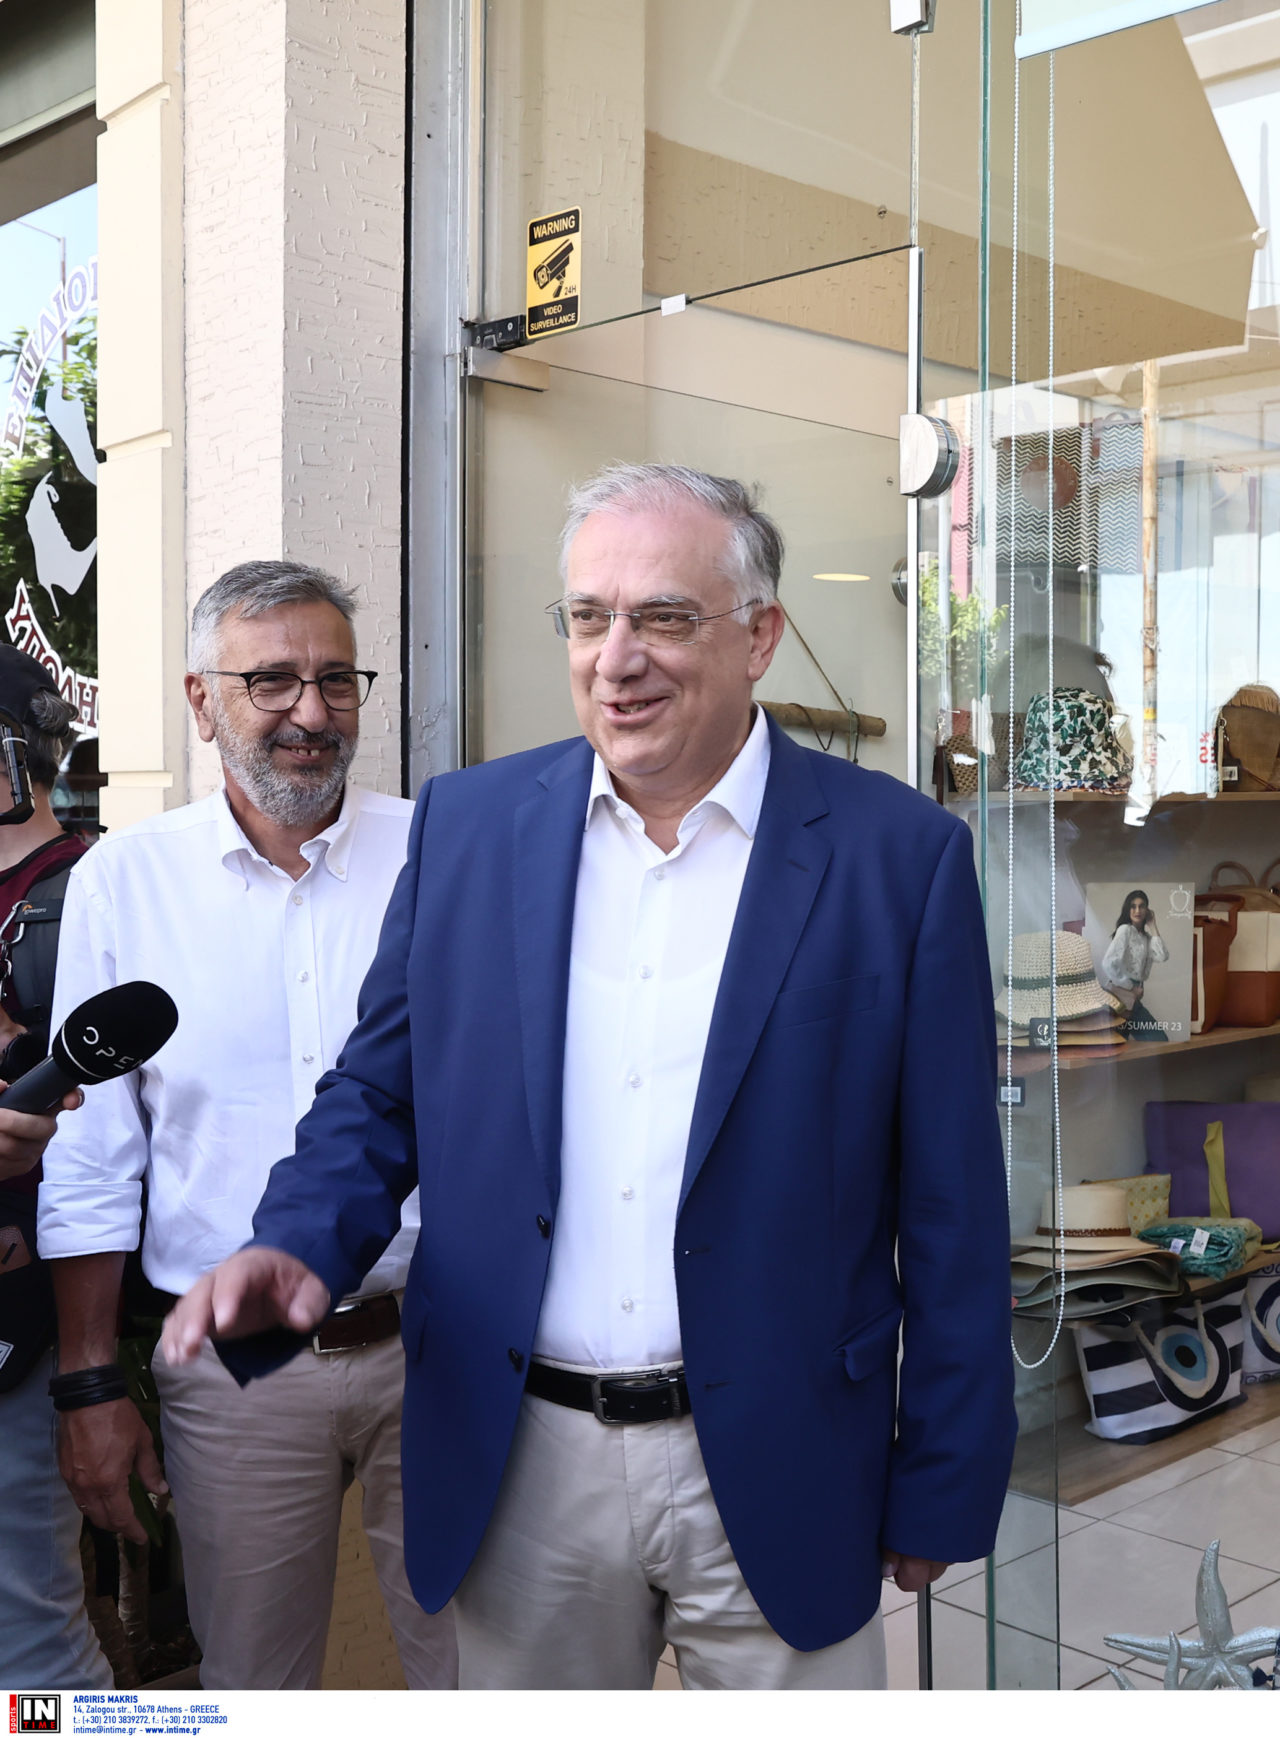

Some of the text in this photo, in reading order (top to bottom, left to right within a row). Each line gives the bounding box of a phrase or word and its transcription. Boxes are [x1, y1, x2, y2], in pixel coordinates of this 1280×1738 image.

[533, 215, 576, 239] WARNING
[564, 285, 577, 296] 24H
[543, 304, 563, 316] VIDEO
[530, 312, 576, 332] SURVEILLANCE
[1171, 1021, 1182, 1032] 23
